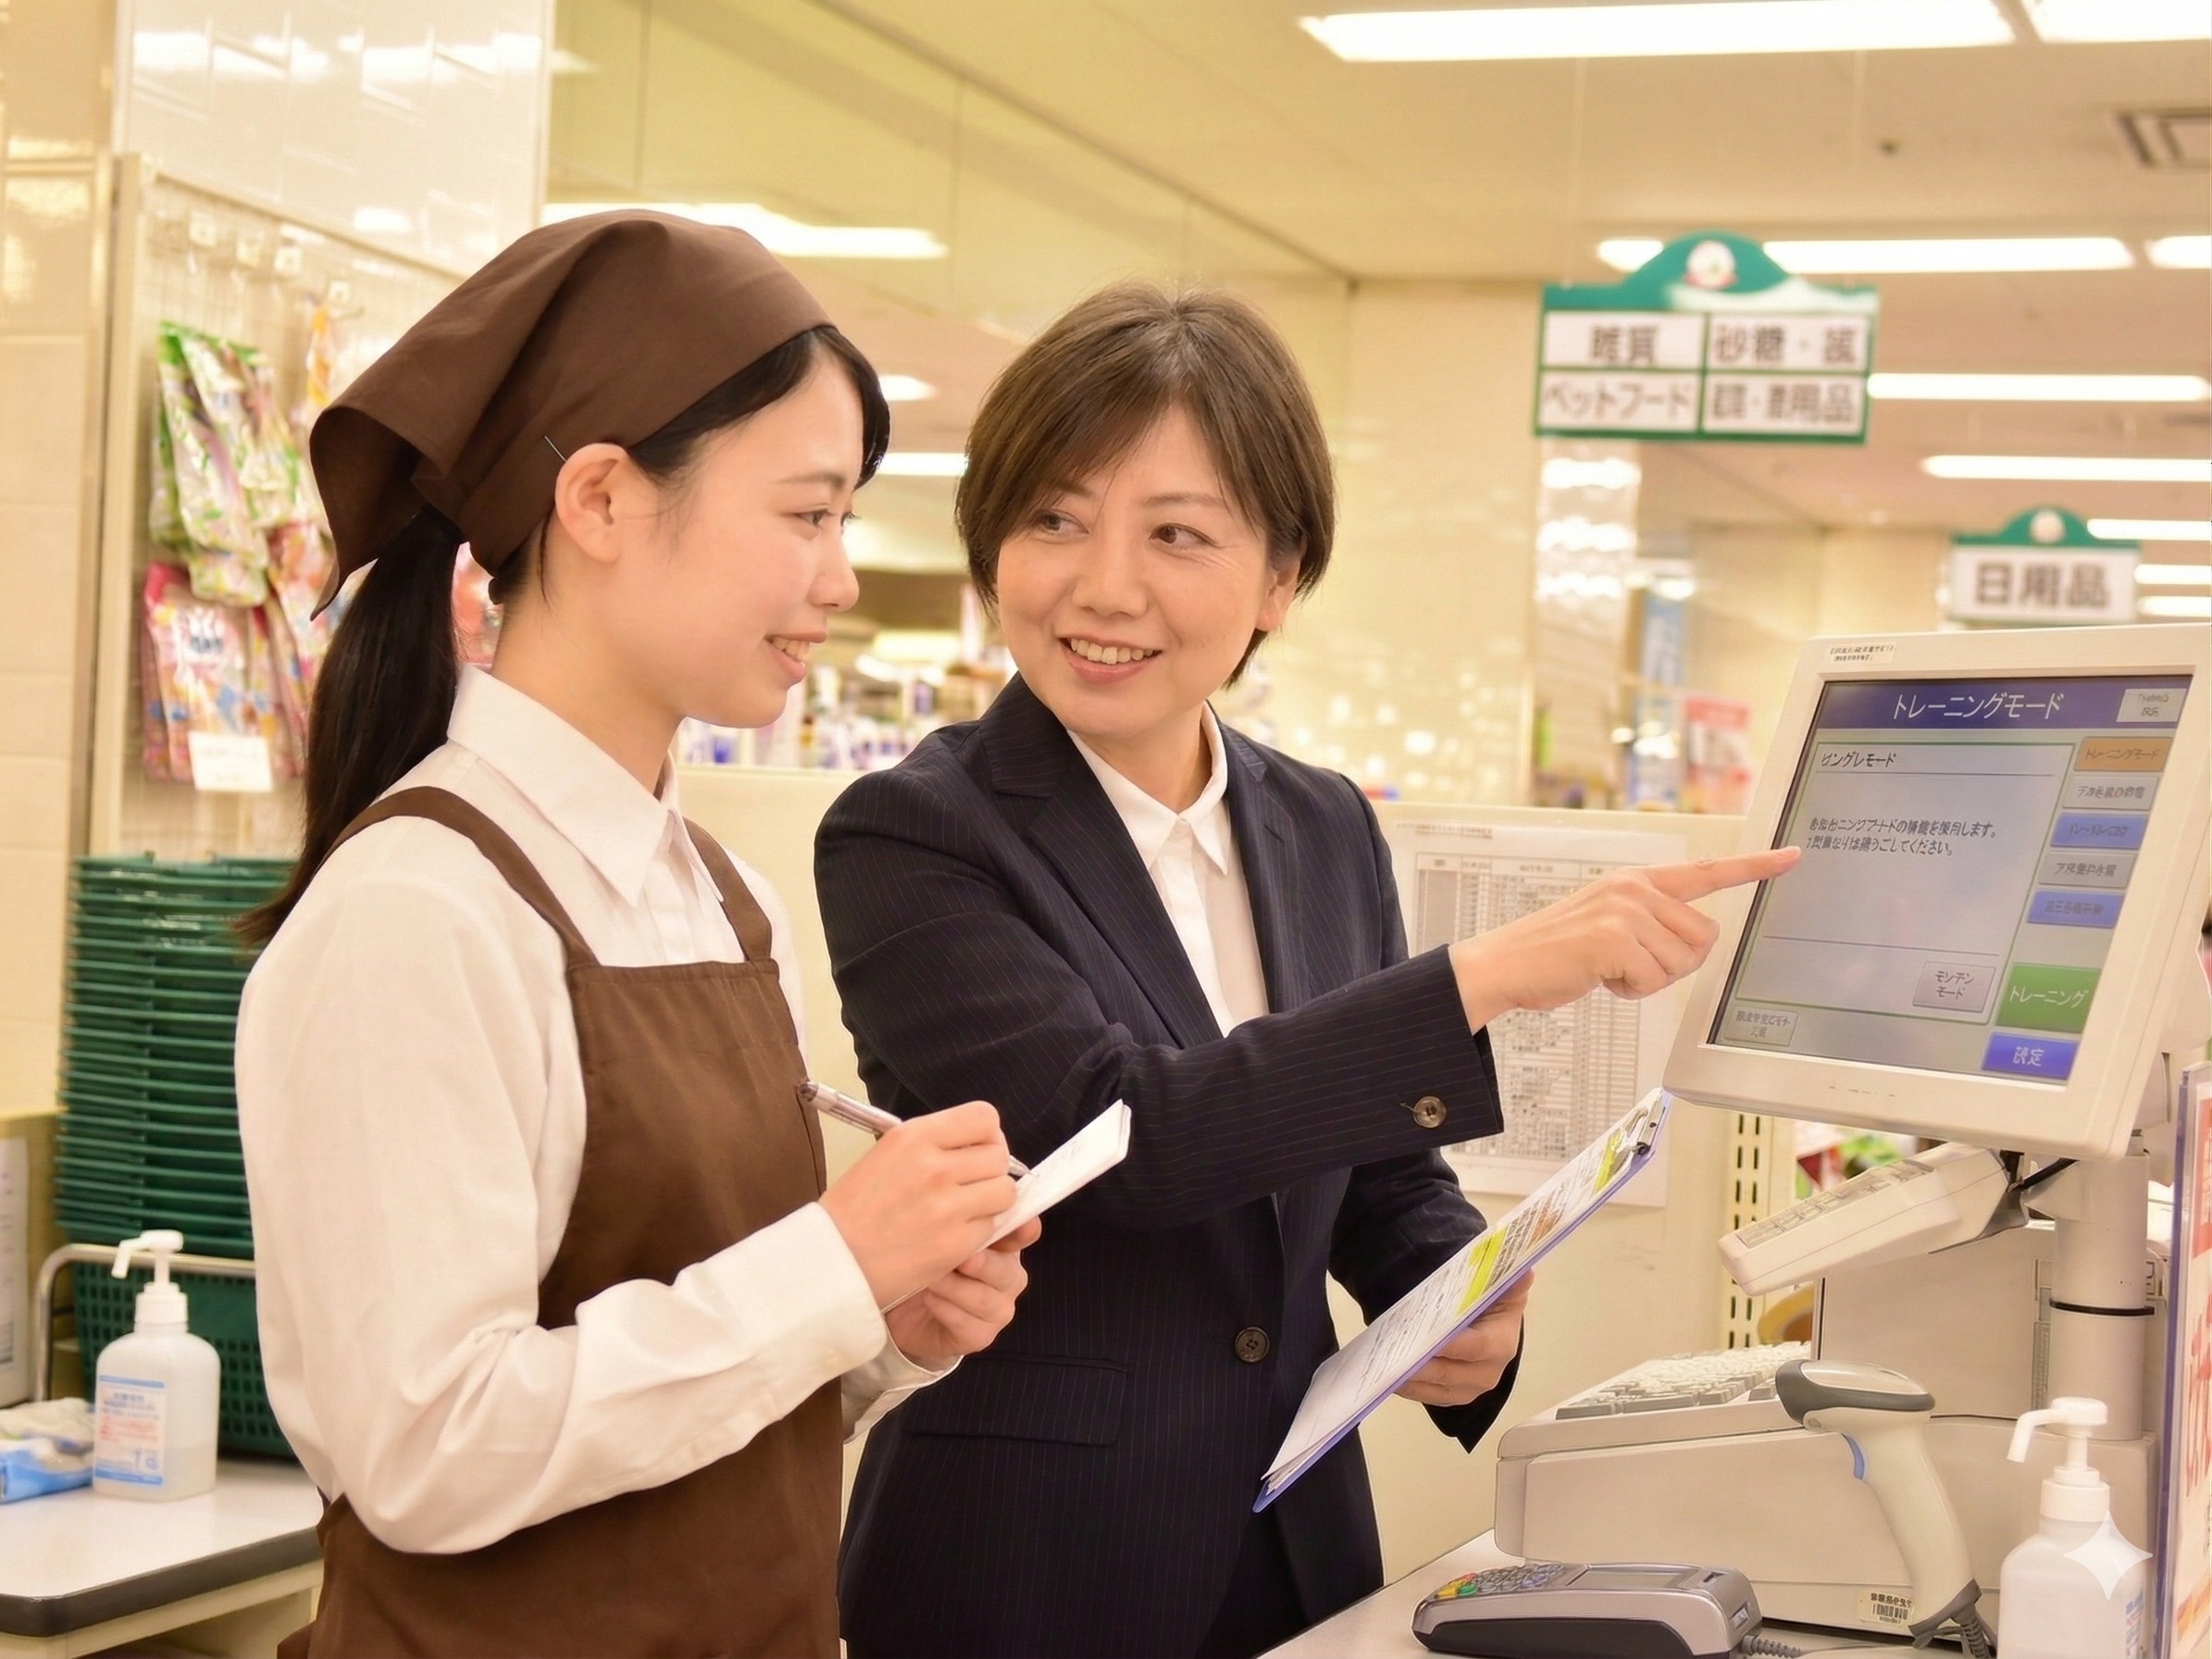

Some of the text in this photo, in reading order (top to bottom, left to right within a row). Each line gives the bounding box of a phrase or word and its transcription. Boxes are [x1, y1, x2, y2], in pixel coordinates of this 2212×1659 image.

[1543, 380, 1695, 418] ペットフード
[1974, 562, 2110, 608] 日用品
[1893, 692, 2065, 720] トレーニングモード
[2009, 984, 2091, 1009] トレーニング
